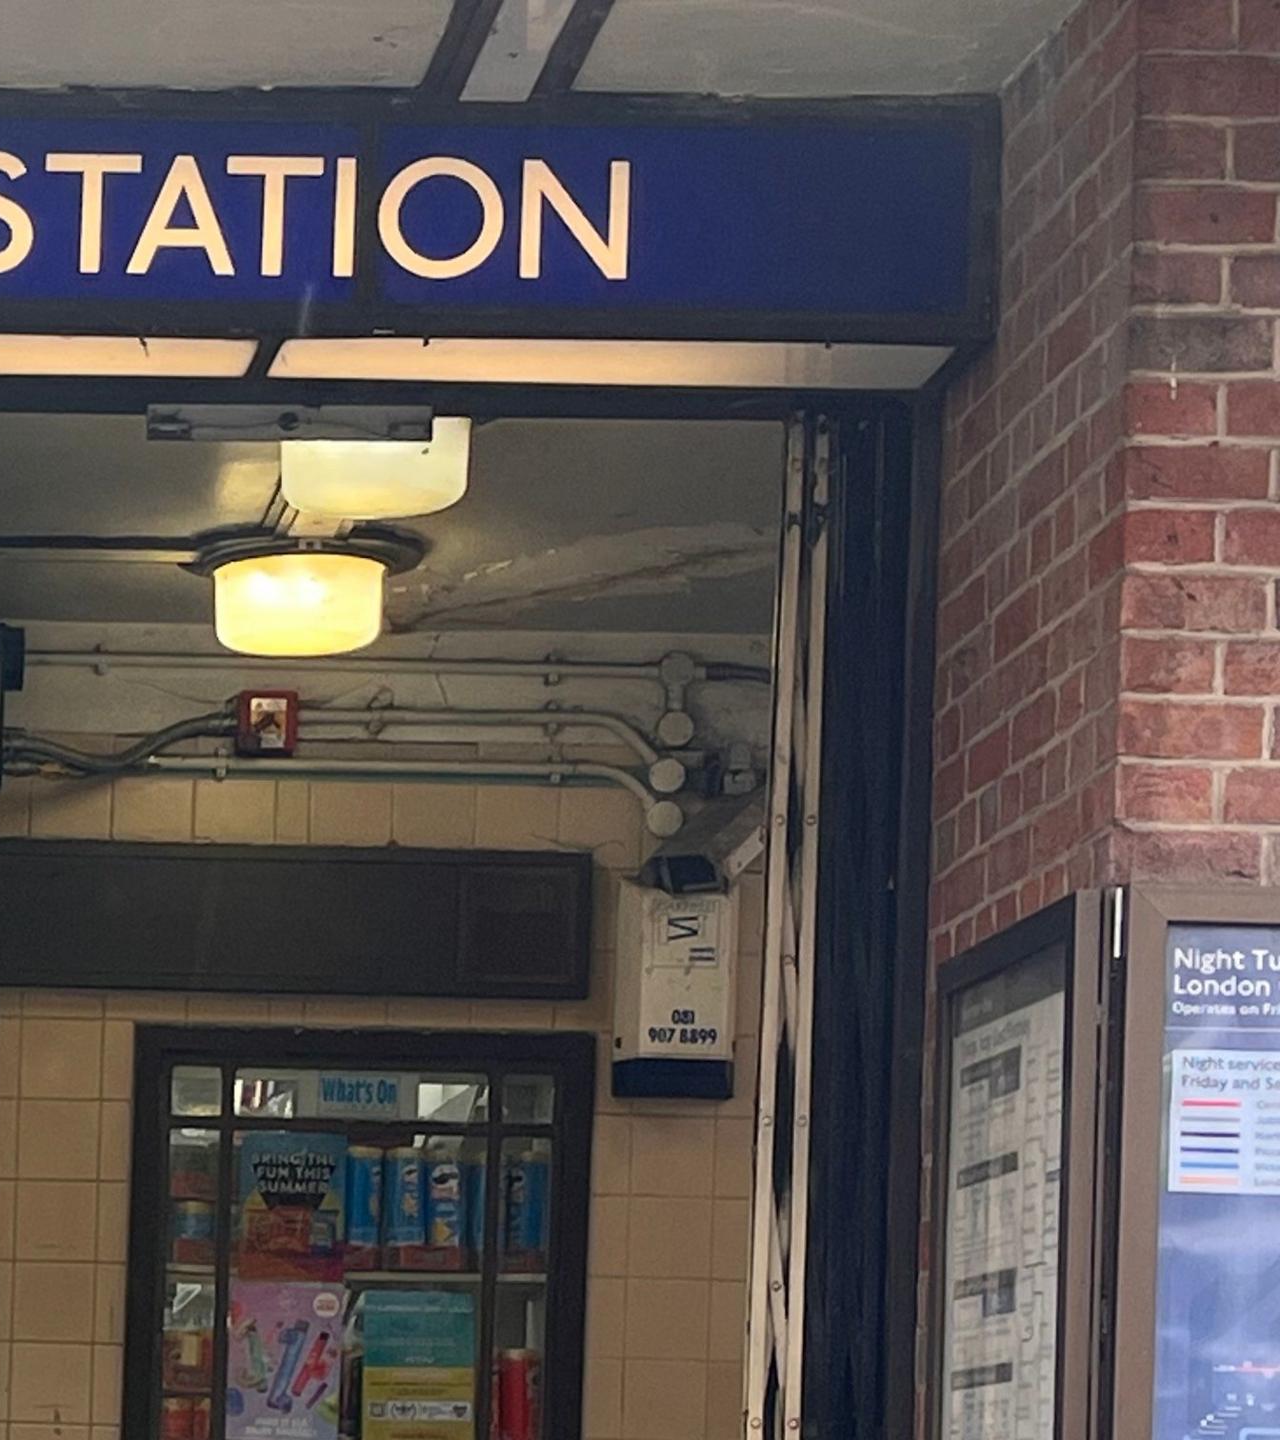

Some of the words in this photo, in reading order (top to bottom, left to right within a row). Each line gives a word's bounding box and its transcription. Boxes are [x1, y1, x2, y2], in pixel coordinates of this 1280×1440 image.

[1173, 947, 1245, 974] Night
[1173, 973, 1271, 997] London
[648, 1027, 675, 1044] 907
[1182, 1056, 1225, 1072] Night
[321, 1077, 372, 1103] What's
[377, 1079, 397, 1105] On
[1181, 1074, 1228, 1092] Friday
[1232, 1077, 1260, 1090] and
[256, 1166, 291, 1178] FUN
[295, 1165, 332, 1180] THIS
[257, 1180, 329, 1194] SUMMER
